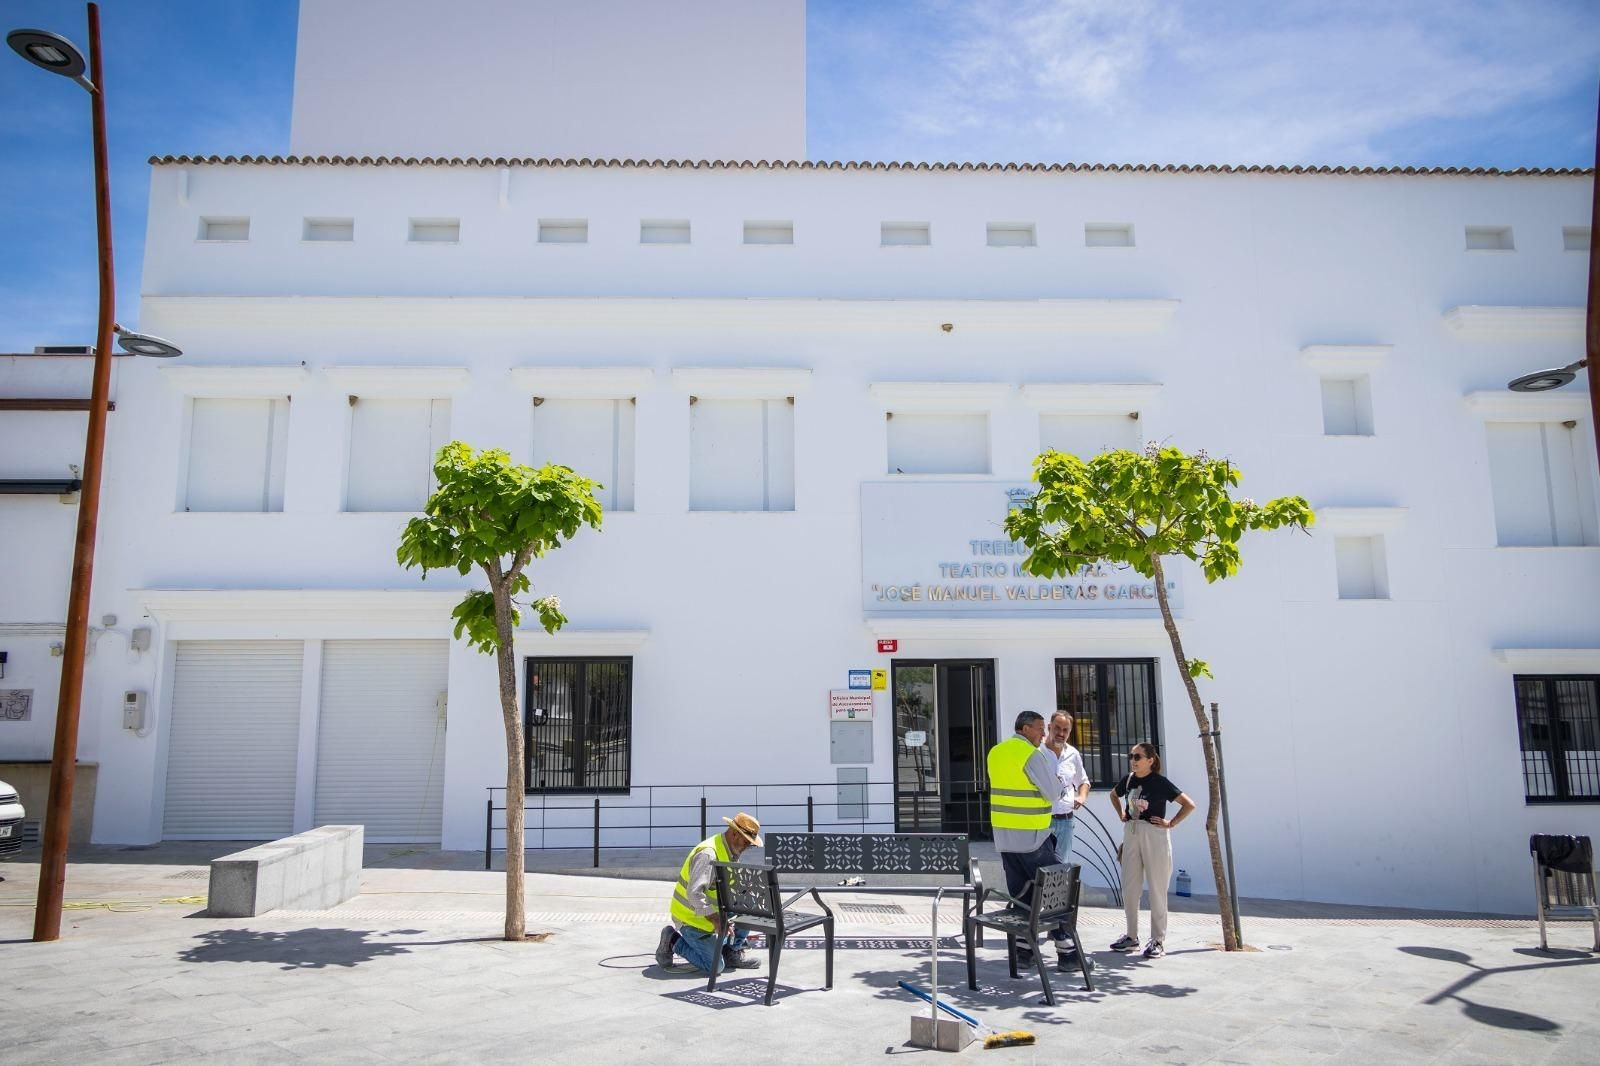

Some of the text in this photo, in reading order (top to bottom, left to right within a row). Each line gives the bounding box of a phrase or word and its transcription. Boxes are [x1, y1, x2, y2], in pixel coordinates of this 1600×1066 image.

[969, 540, 1031, 556] TREBU
[938, 562, 1008, 578] TEATRO
[928, 585, 1000, 601] MANUEL
[1005, 584, 1099, 601] VALDERAS
